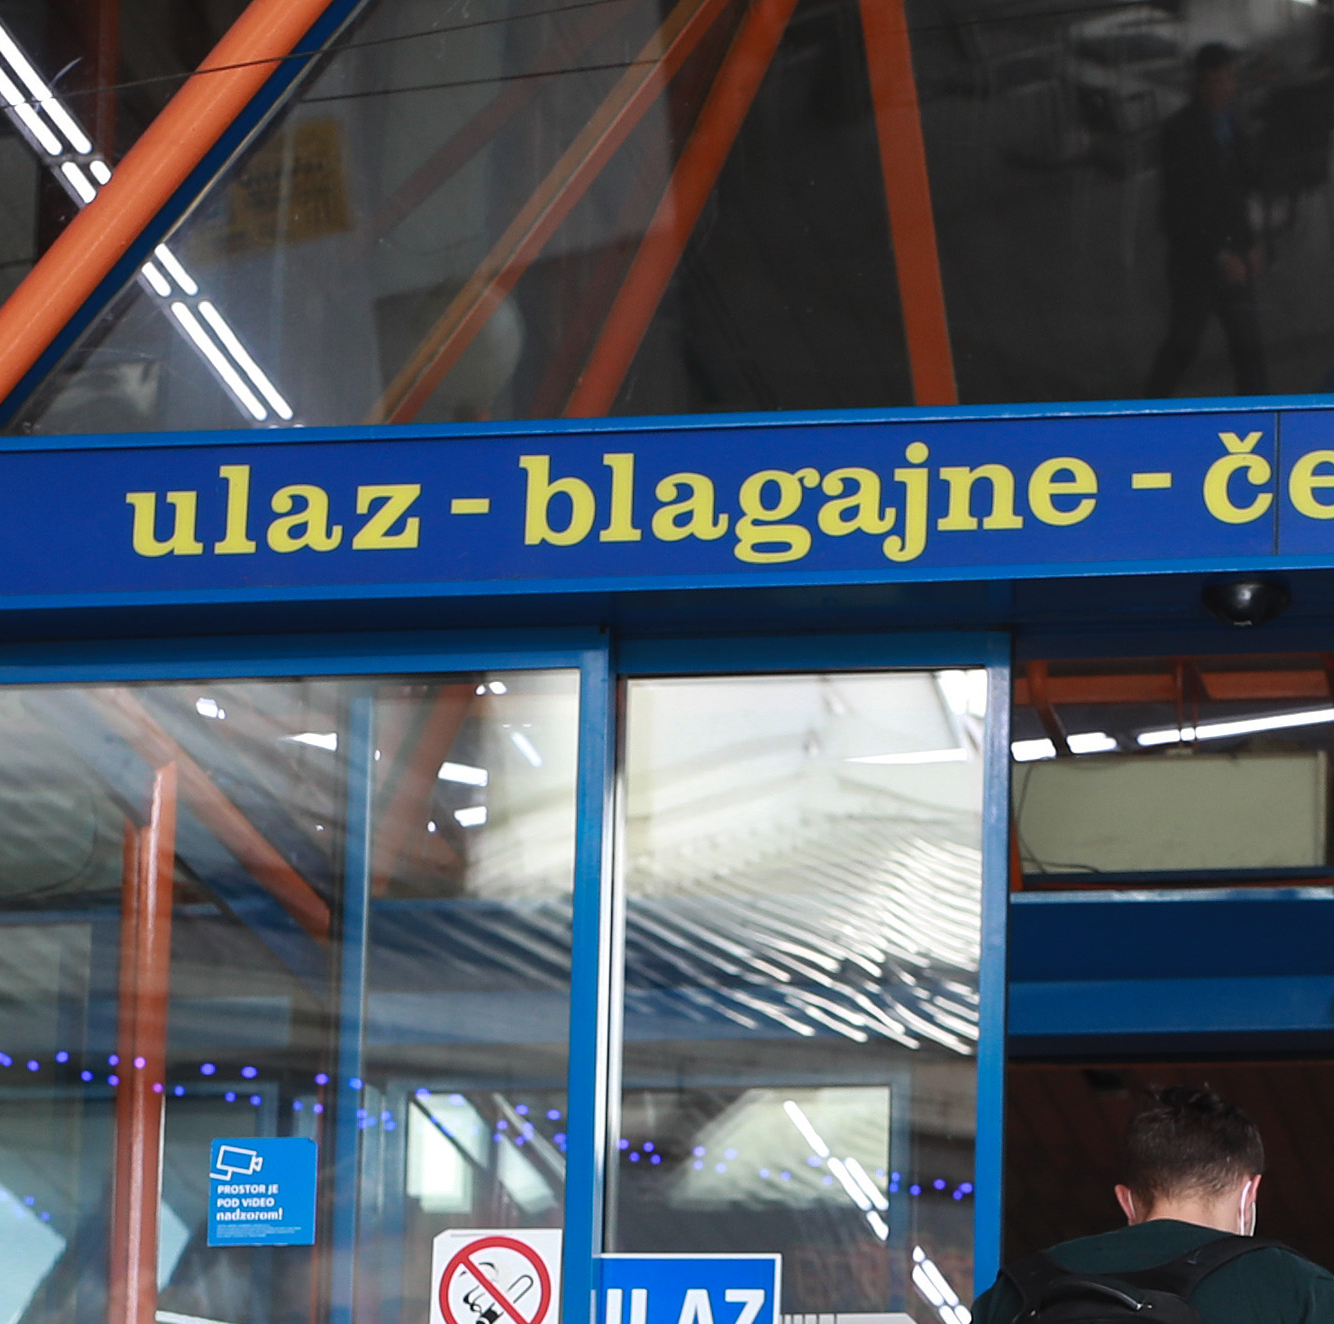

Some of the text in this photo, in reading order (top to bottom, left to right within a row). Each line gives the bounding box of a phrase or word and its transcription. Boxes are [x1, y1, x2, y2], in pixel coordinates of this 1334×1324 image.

[126, 465, 421, 557] ulaz
[520, 442, 1098, 563] blagajne
[217, 1184, 279, 1195] PROSTOR JE
[216, 1197, 276, 1208] POD VIDEO
[216, 1207, 284, 1222] nadzorom!
